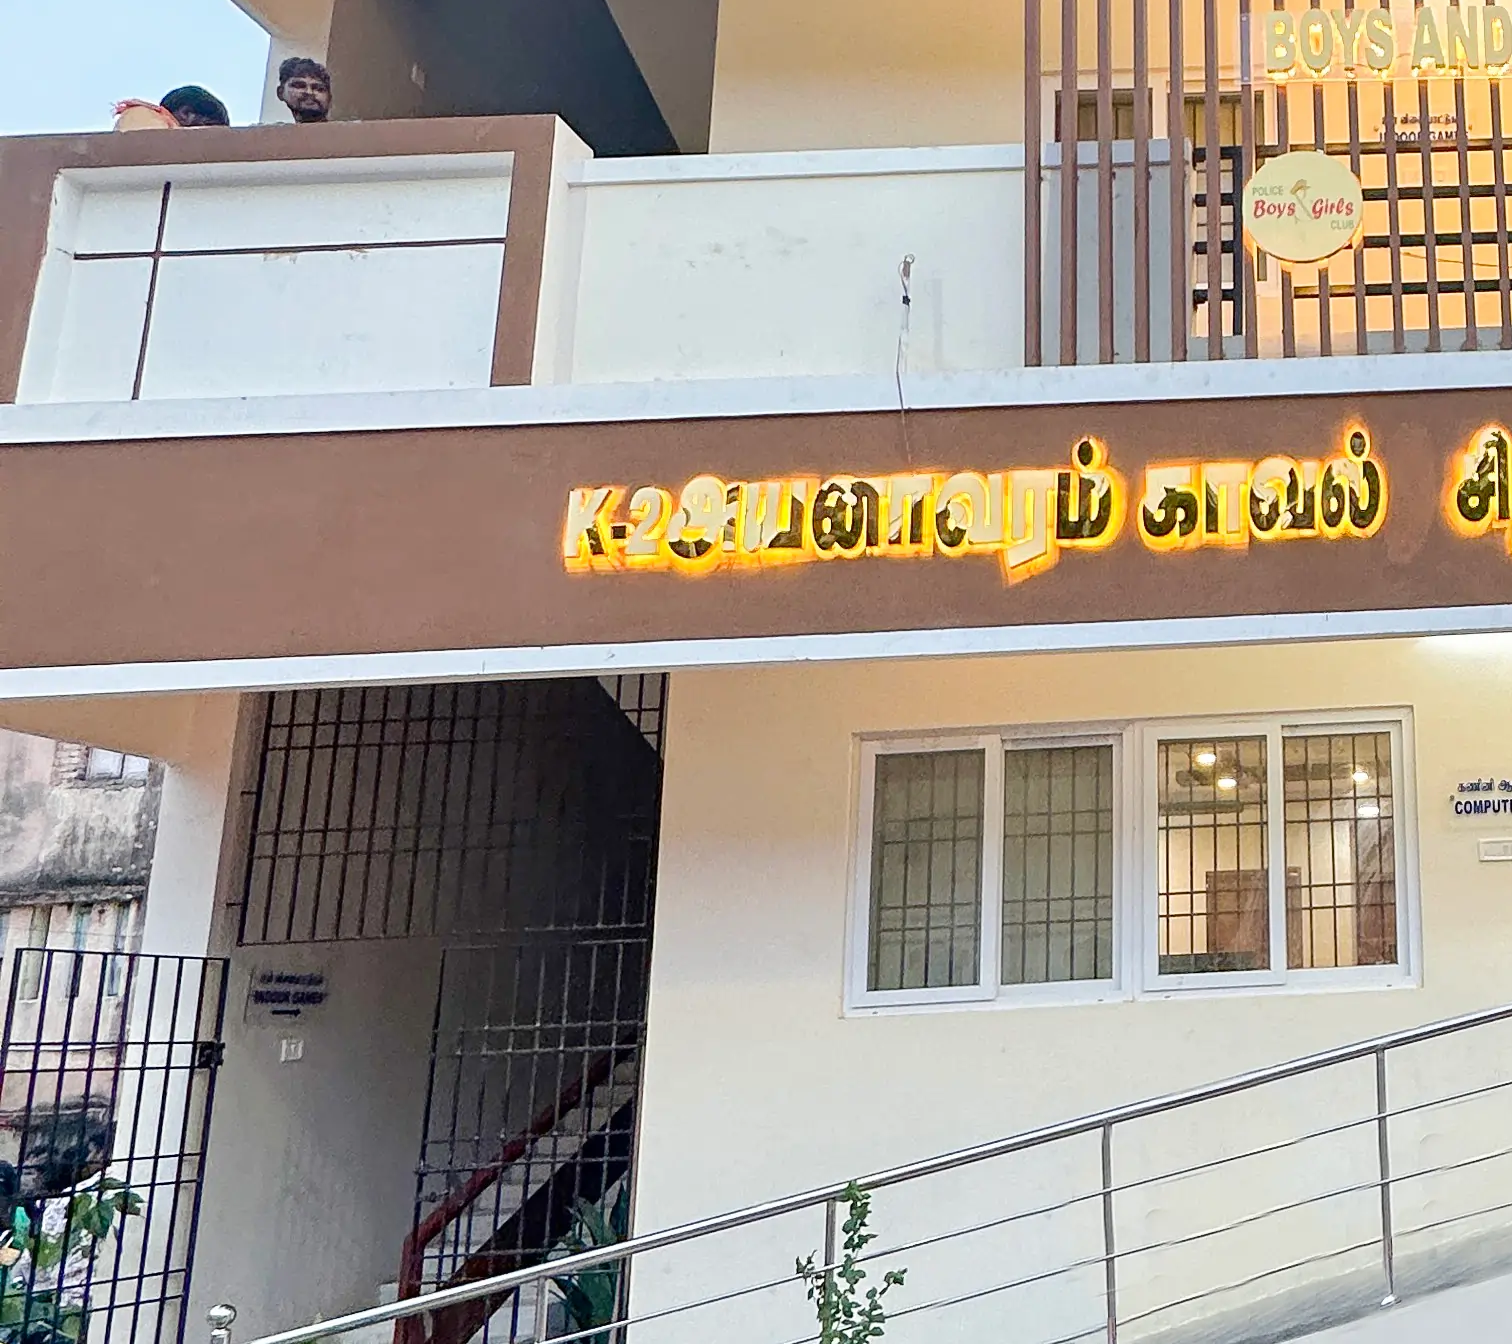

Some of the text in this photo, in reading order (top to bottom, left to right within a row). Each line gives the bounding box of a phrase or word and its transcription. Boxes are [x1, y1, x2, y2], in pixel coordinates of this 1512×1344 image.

[1266, 8, 1393, 73] BOYS
[1411, 6, 1512, 70] AND
[1252, 185, 1284, 196] POLICE
[1253, 197, 1354, 220] Boys Girls
[1330, 220, 1354, 230] CLUB
[1142, 431, 1385, 540] காவல்
